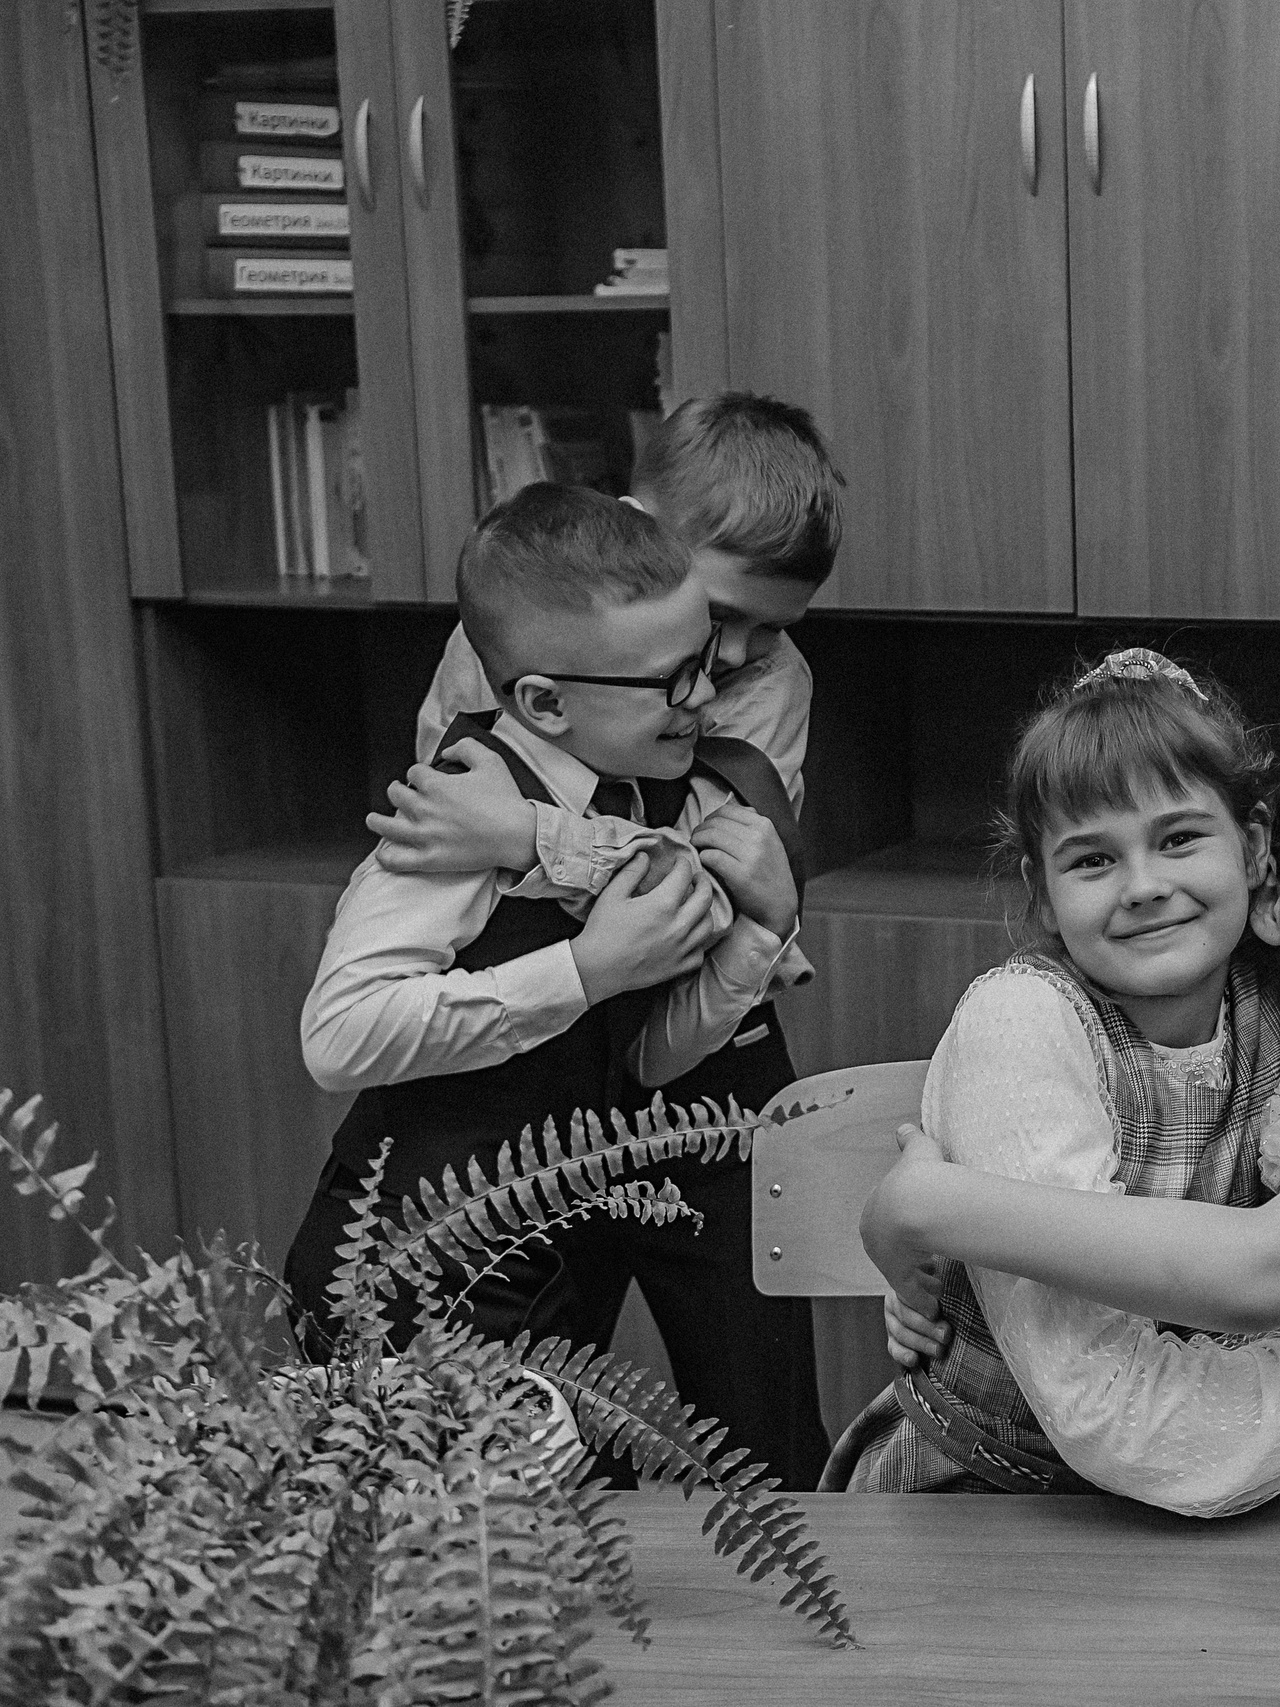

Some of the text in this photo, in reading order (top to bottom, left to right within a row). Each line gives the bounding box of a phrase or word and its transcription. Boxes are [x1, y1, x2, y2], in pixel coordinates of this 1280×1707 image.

[249, 110, 330, 131] Картинки
[251, 164, 332, 183] Картинки
[223, 210, 311, 230] Геометрия
[240, 266, 327, 286] Геометрия
